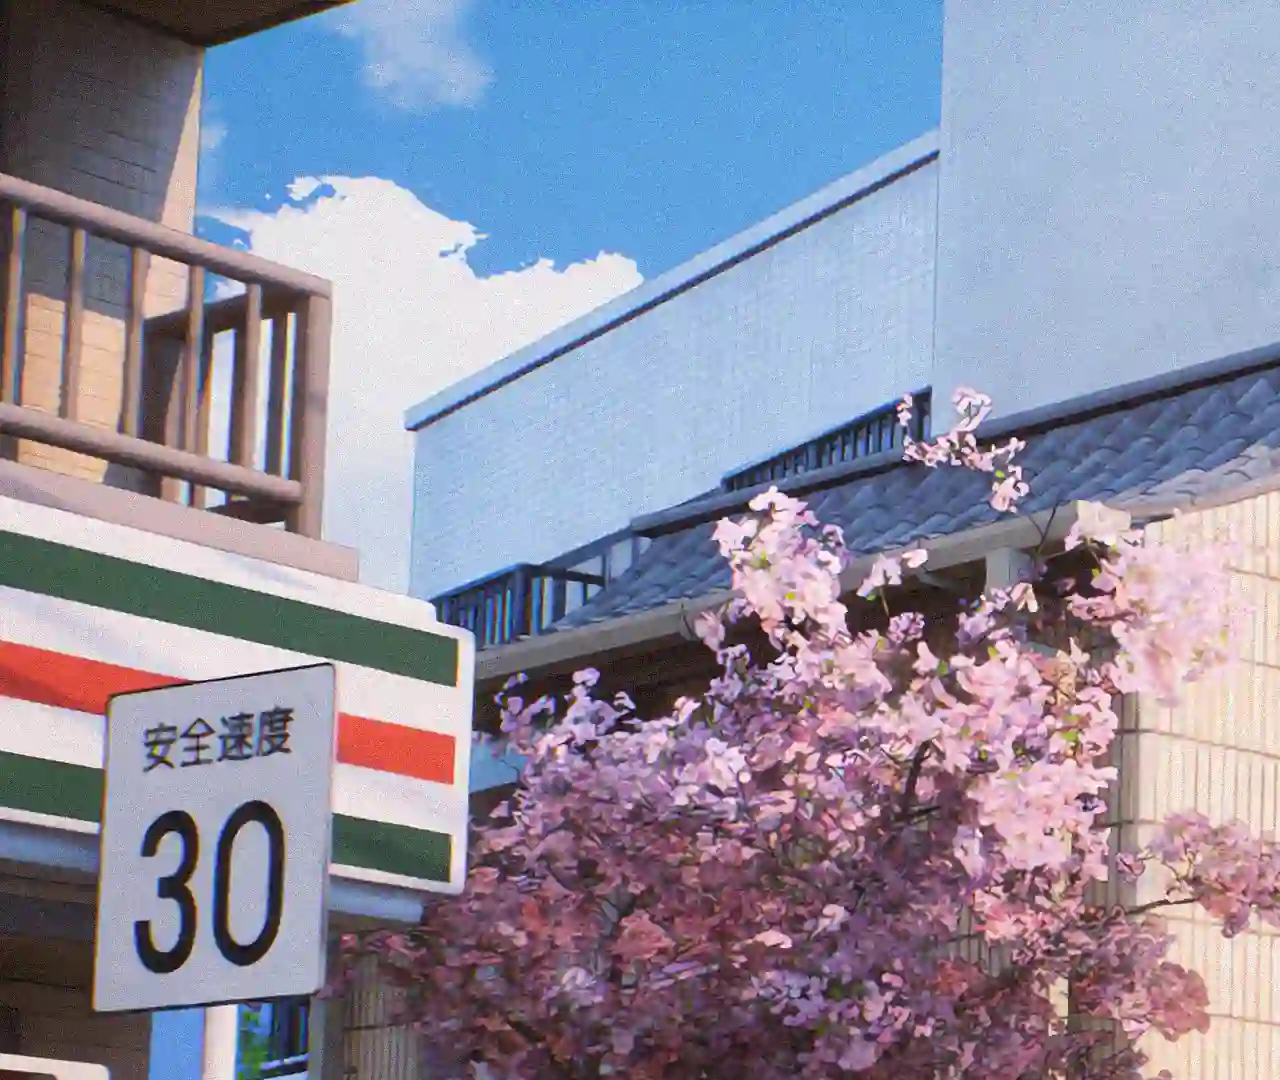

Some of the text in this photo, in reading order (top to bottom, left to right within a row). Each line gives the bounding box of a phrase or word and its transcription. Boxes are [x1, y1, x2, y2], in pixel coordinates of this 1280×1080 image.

[143, 707, 296, 773] 安全速度
[134, 799, 285, 975] 30
